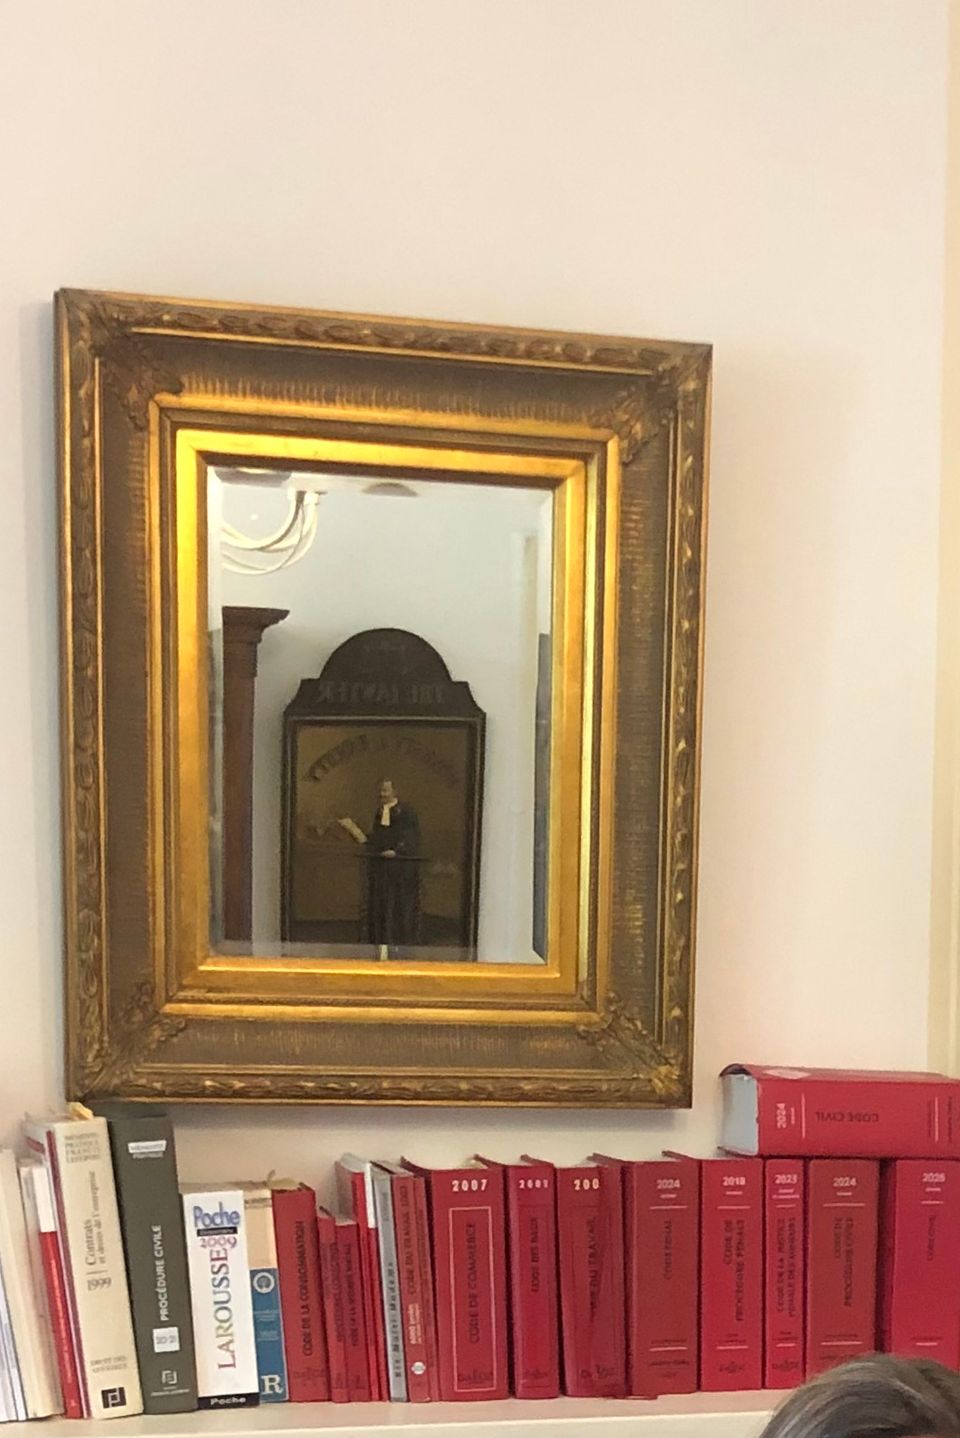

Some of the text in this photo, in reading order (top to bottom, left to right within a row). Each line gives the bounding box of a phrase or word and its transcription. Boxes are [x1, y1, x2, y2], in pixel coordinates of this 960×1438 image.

[815, 1111, 879, 1122] CODE CIVIL
[452, 1179, 488, 1192] 2007
[656, 1178, 681, 1190] 2024
[832, 1177, 857, 1188] 2024
[192, 1202, 241, 1229] Poche
[150, 1225, 162, 1257] CIVILE
[199, 1236, 238, 1249] 2009
[87, 1277, 112, 1292] 1999
[465, 1222, 480, 1345] CODE DE COMMERCE
[153, 1260, 170, 1321] PROCÉDURE
[209, 1248, 236, 1369] LAROUSSE
[300, 1303, 310, 1314] LA
[301, 1317, 311, 1328] DE
[302, 1329, 313, 1356] CODE
[210, 1397, 247, 1406] Poche
